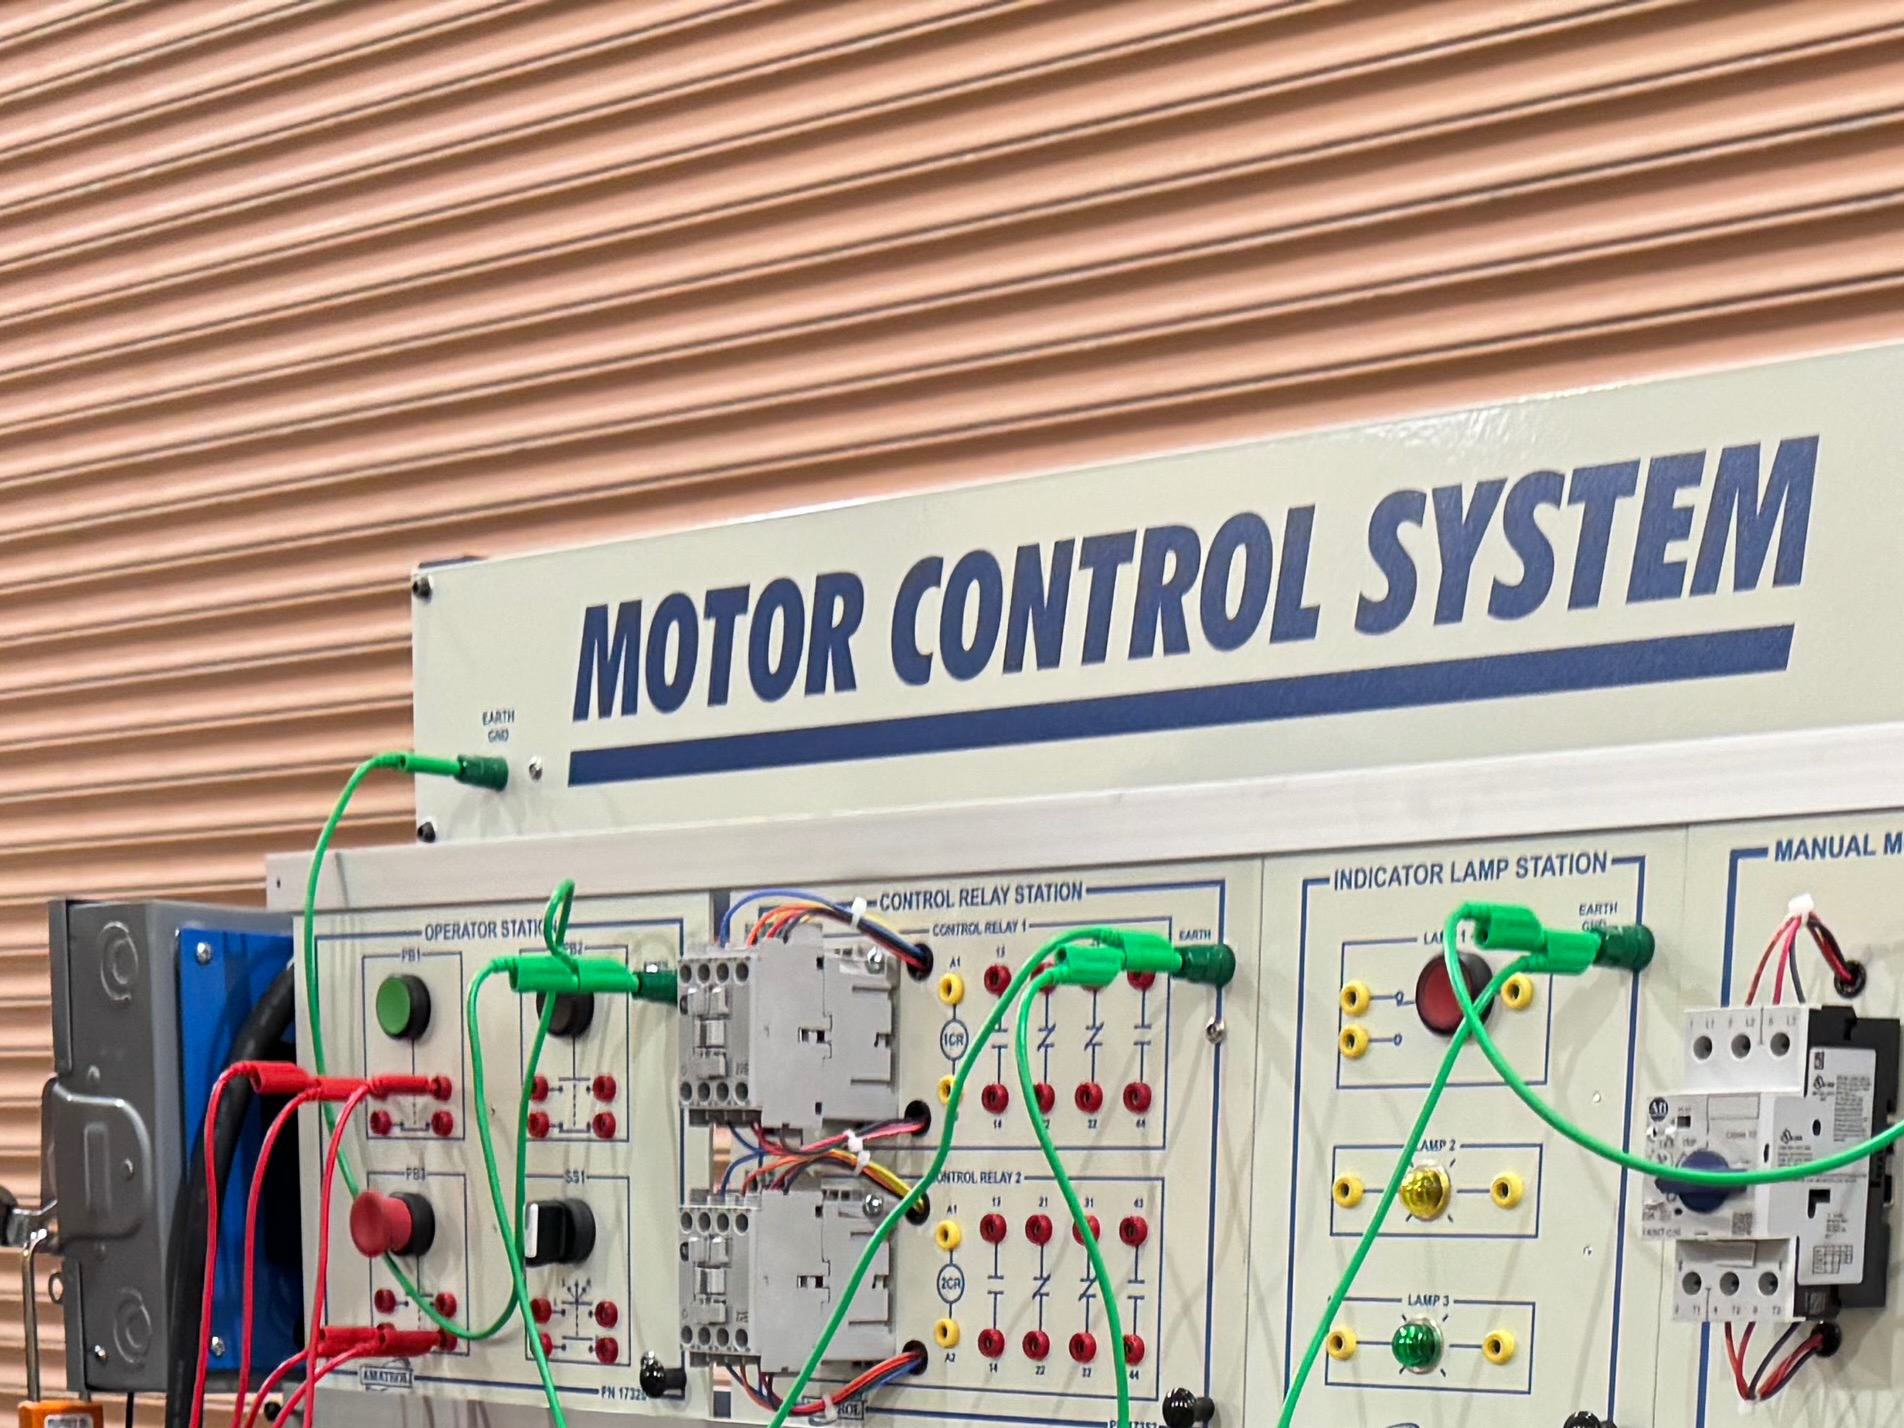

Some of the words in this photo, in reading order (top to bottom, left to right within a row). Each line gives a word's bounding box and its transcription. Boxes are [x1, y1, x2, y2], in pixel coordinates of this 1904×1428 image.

[572, 570, 861, 723] MOTOR
[888, 515, 1327, 682] CONTROL
[1352, 432, 1823, 637] SYSTEM
[482, 709, 515, 725] EARTH
[1774, 831, 1876, 863] MANUAL
[1333, 863, 1444, 891] INDICATOR
[1450, 859, 1509, 883] LAMP
[1515, 851, 1608, 879] STATION
[879, 889, 953, 913] CONTROL
[959, 885, 1010, 908] RELAY
[1014, 881, 1084, 904] STATION
[1578, 902, 1618, 916] EARTH
[424, 921, 497, 942] OPERATOR
[501, 918, 557, 938] STATI
[932, 923, 983, 937] CONTROL
[984, 921, 1015, 935] RELAY
[1448, 1140, 1456, 1151] 2
[980, 1171, 1012, 1184] RELAY
[1015, 1171, 1022, 1184] 2
[1407, 1295, 1441, 1306] LAMP
[1443, 1295, 1450, 1307] 3
[601, 1385, 616, 1400] PN
